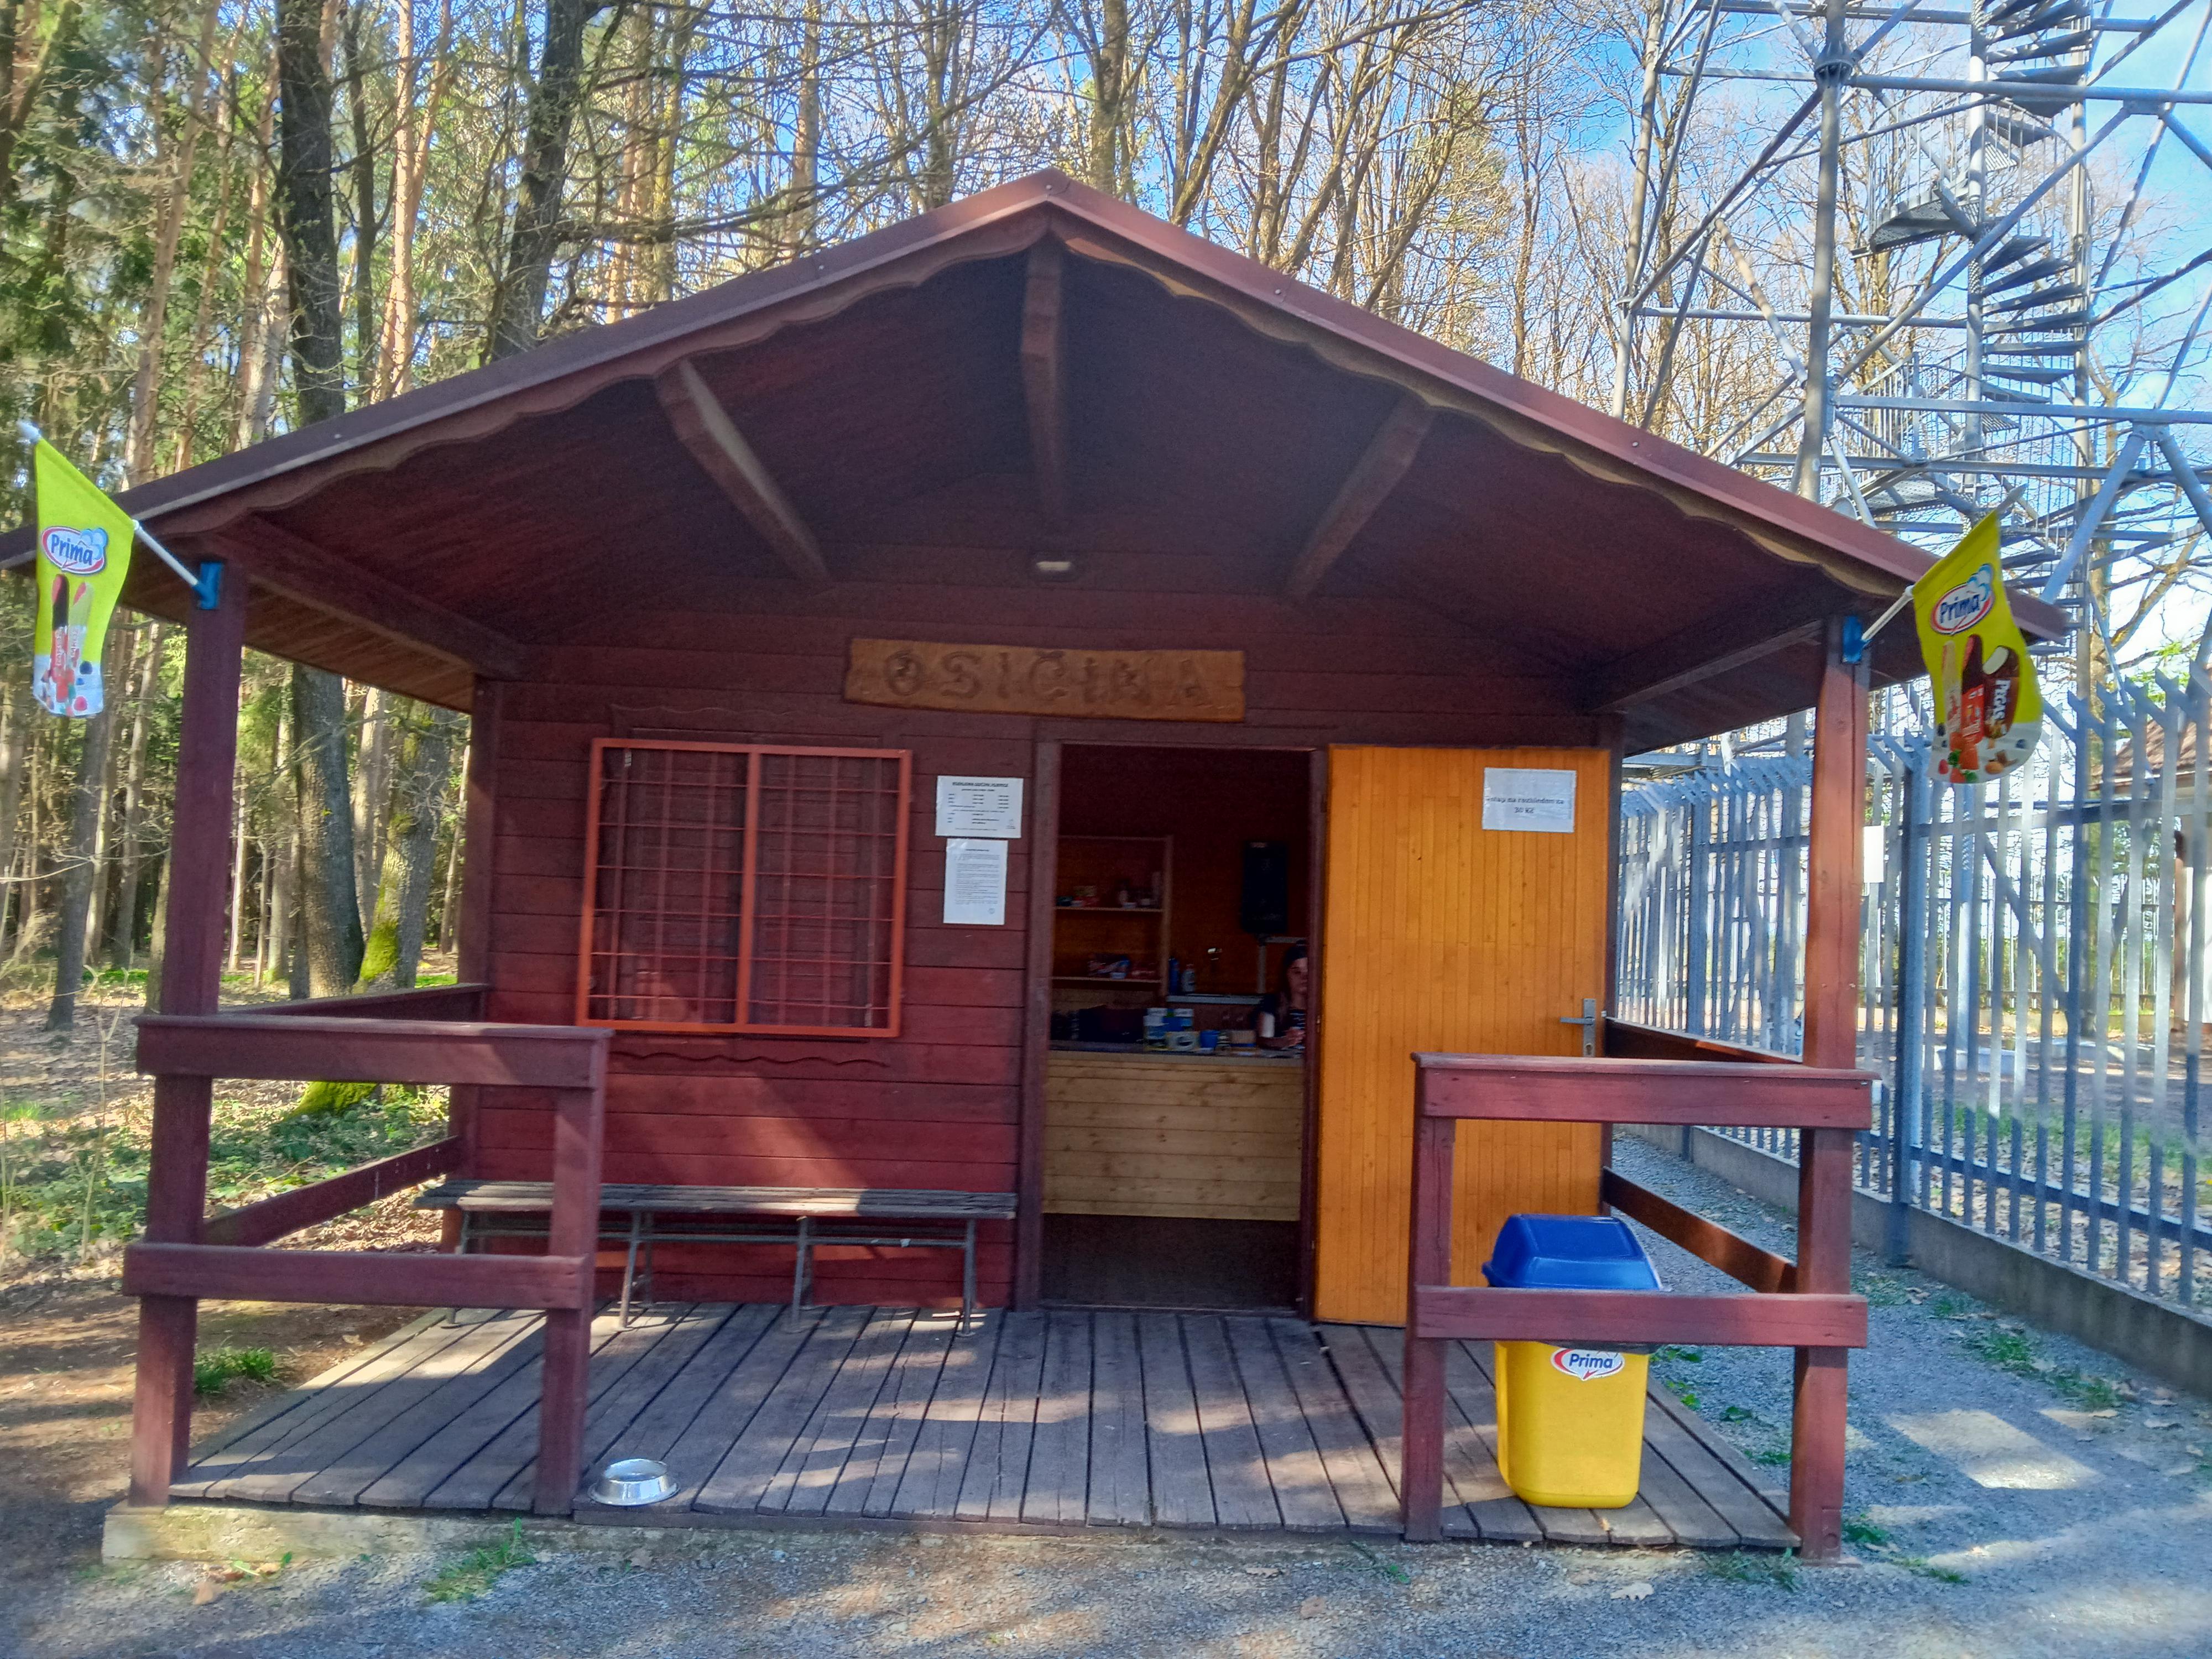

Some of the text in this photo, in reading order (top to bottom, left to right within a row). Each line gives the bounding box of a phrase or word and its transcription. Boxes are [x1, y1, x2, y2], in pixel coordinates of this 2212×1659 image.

[51, 534, 93, 566] Prima
[1940, 594, 1980, 624] Prima
[1569, 1354, 1613, 1369] Prima
